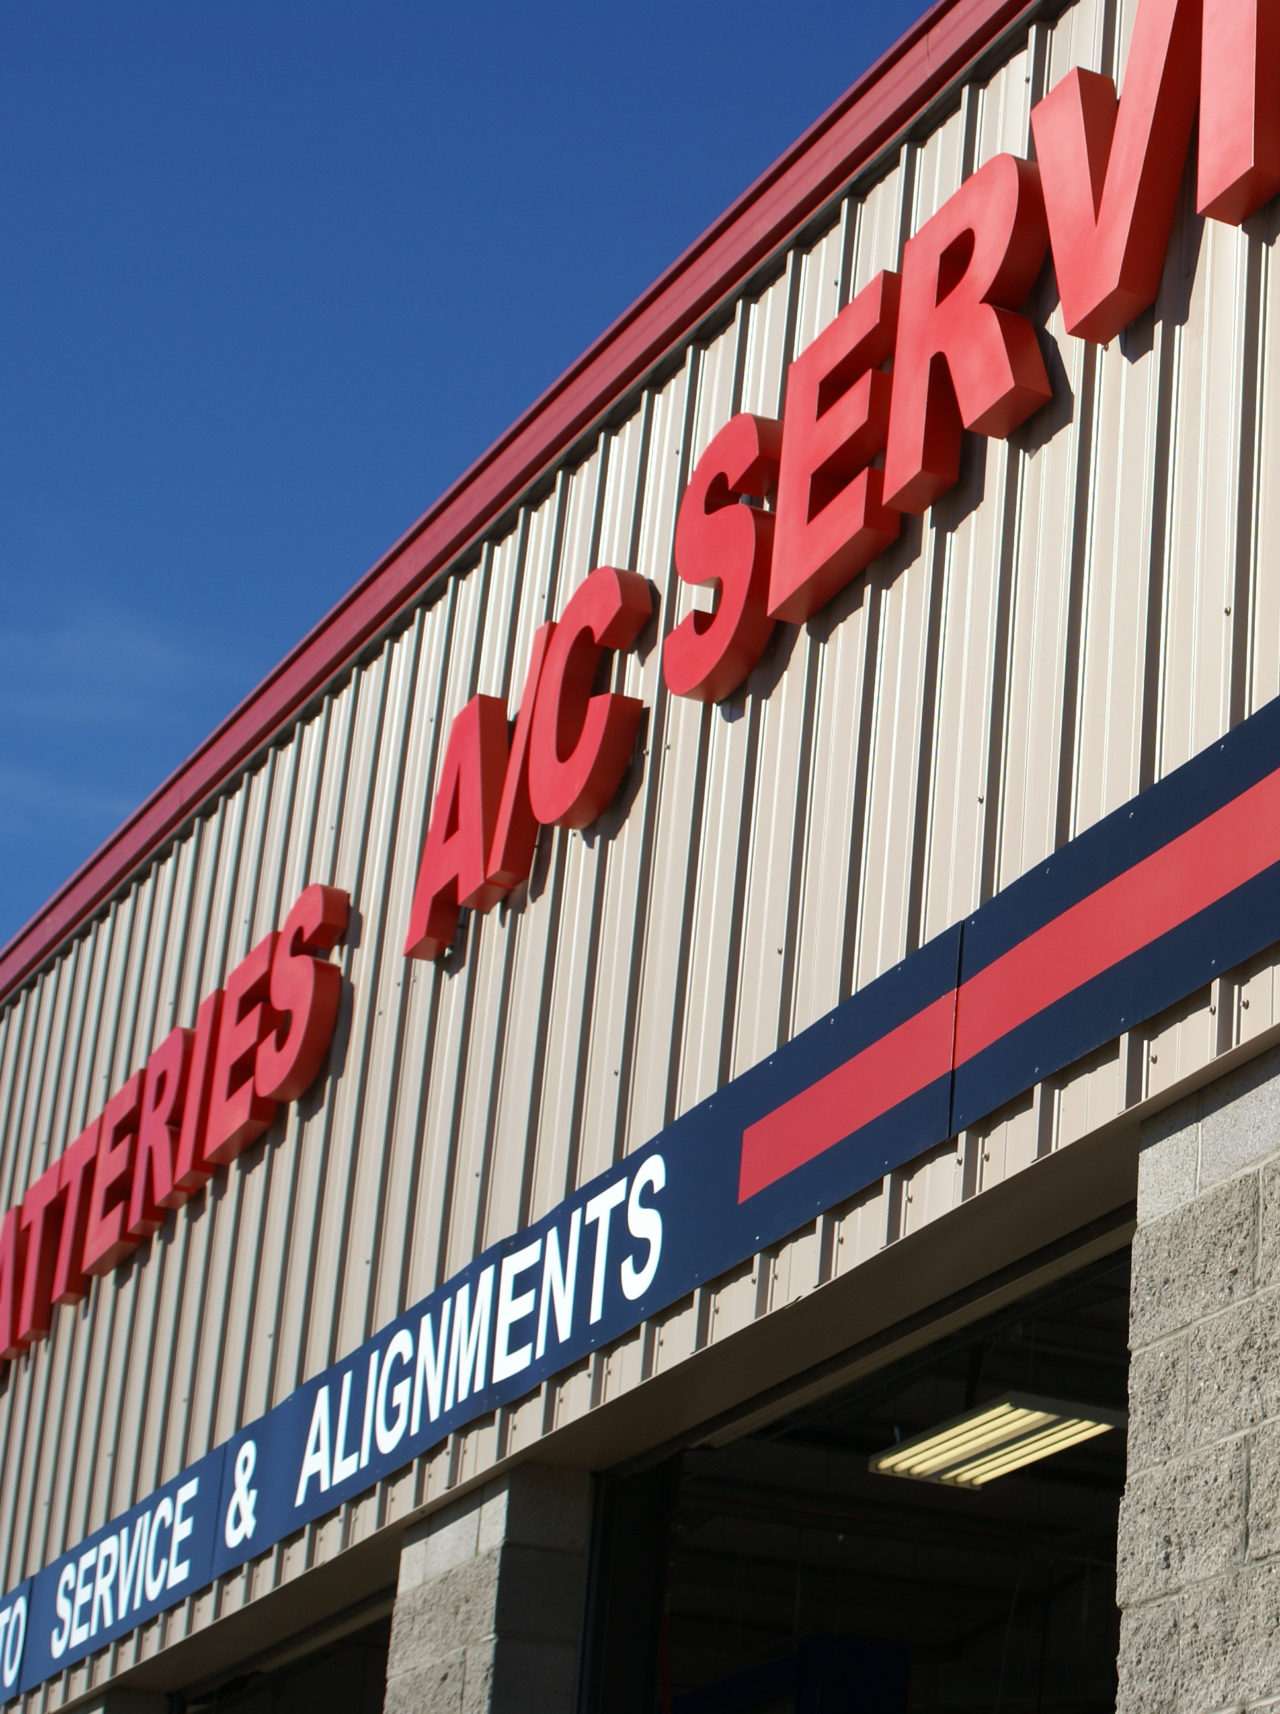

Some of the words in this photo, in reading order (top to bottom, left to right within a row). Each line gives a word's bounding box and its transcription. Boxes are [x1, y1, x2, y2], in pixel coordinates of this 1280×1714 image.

[403, 565, 653, 962] A/C
[51, 1477, 199, 1660] SERVICE
[224, 1440, 258, 1549] &
[294, 1154, 667, 1508] ALIGNMENTS
